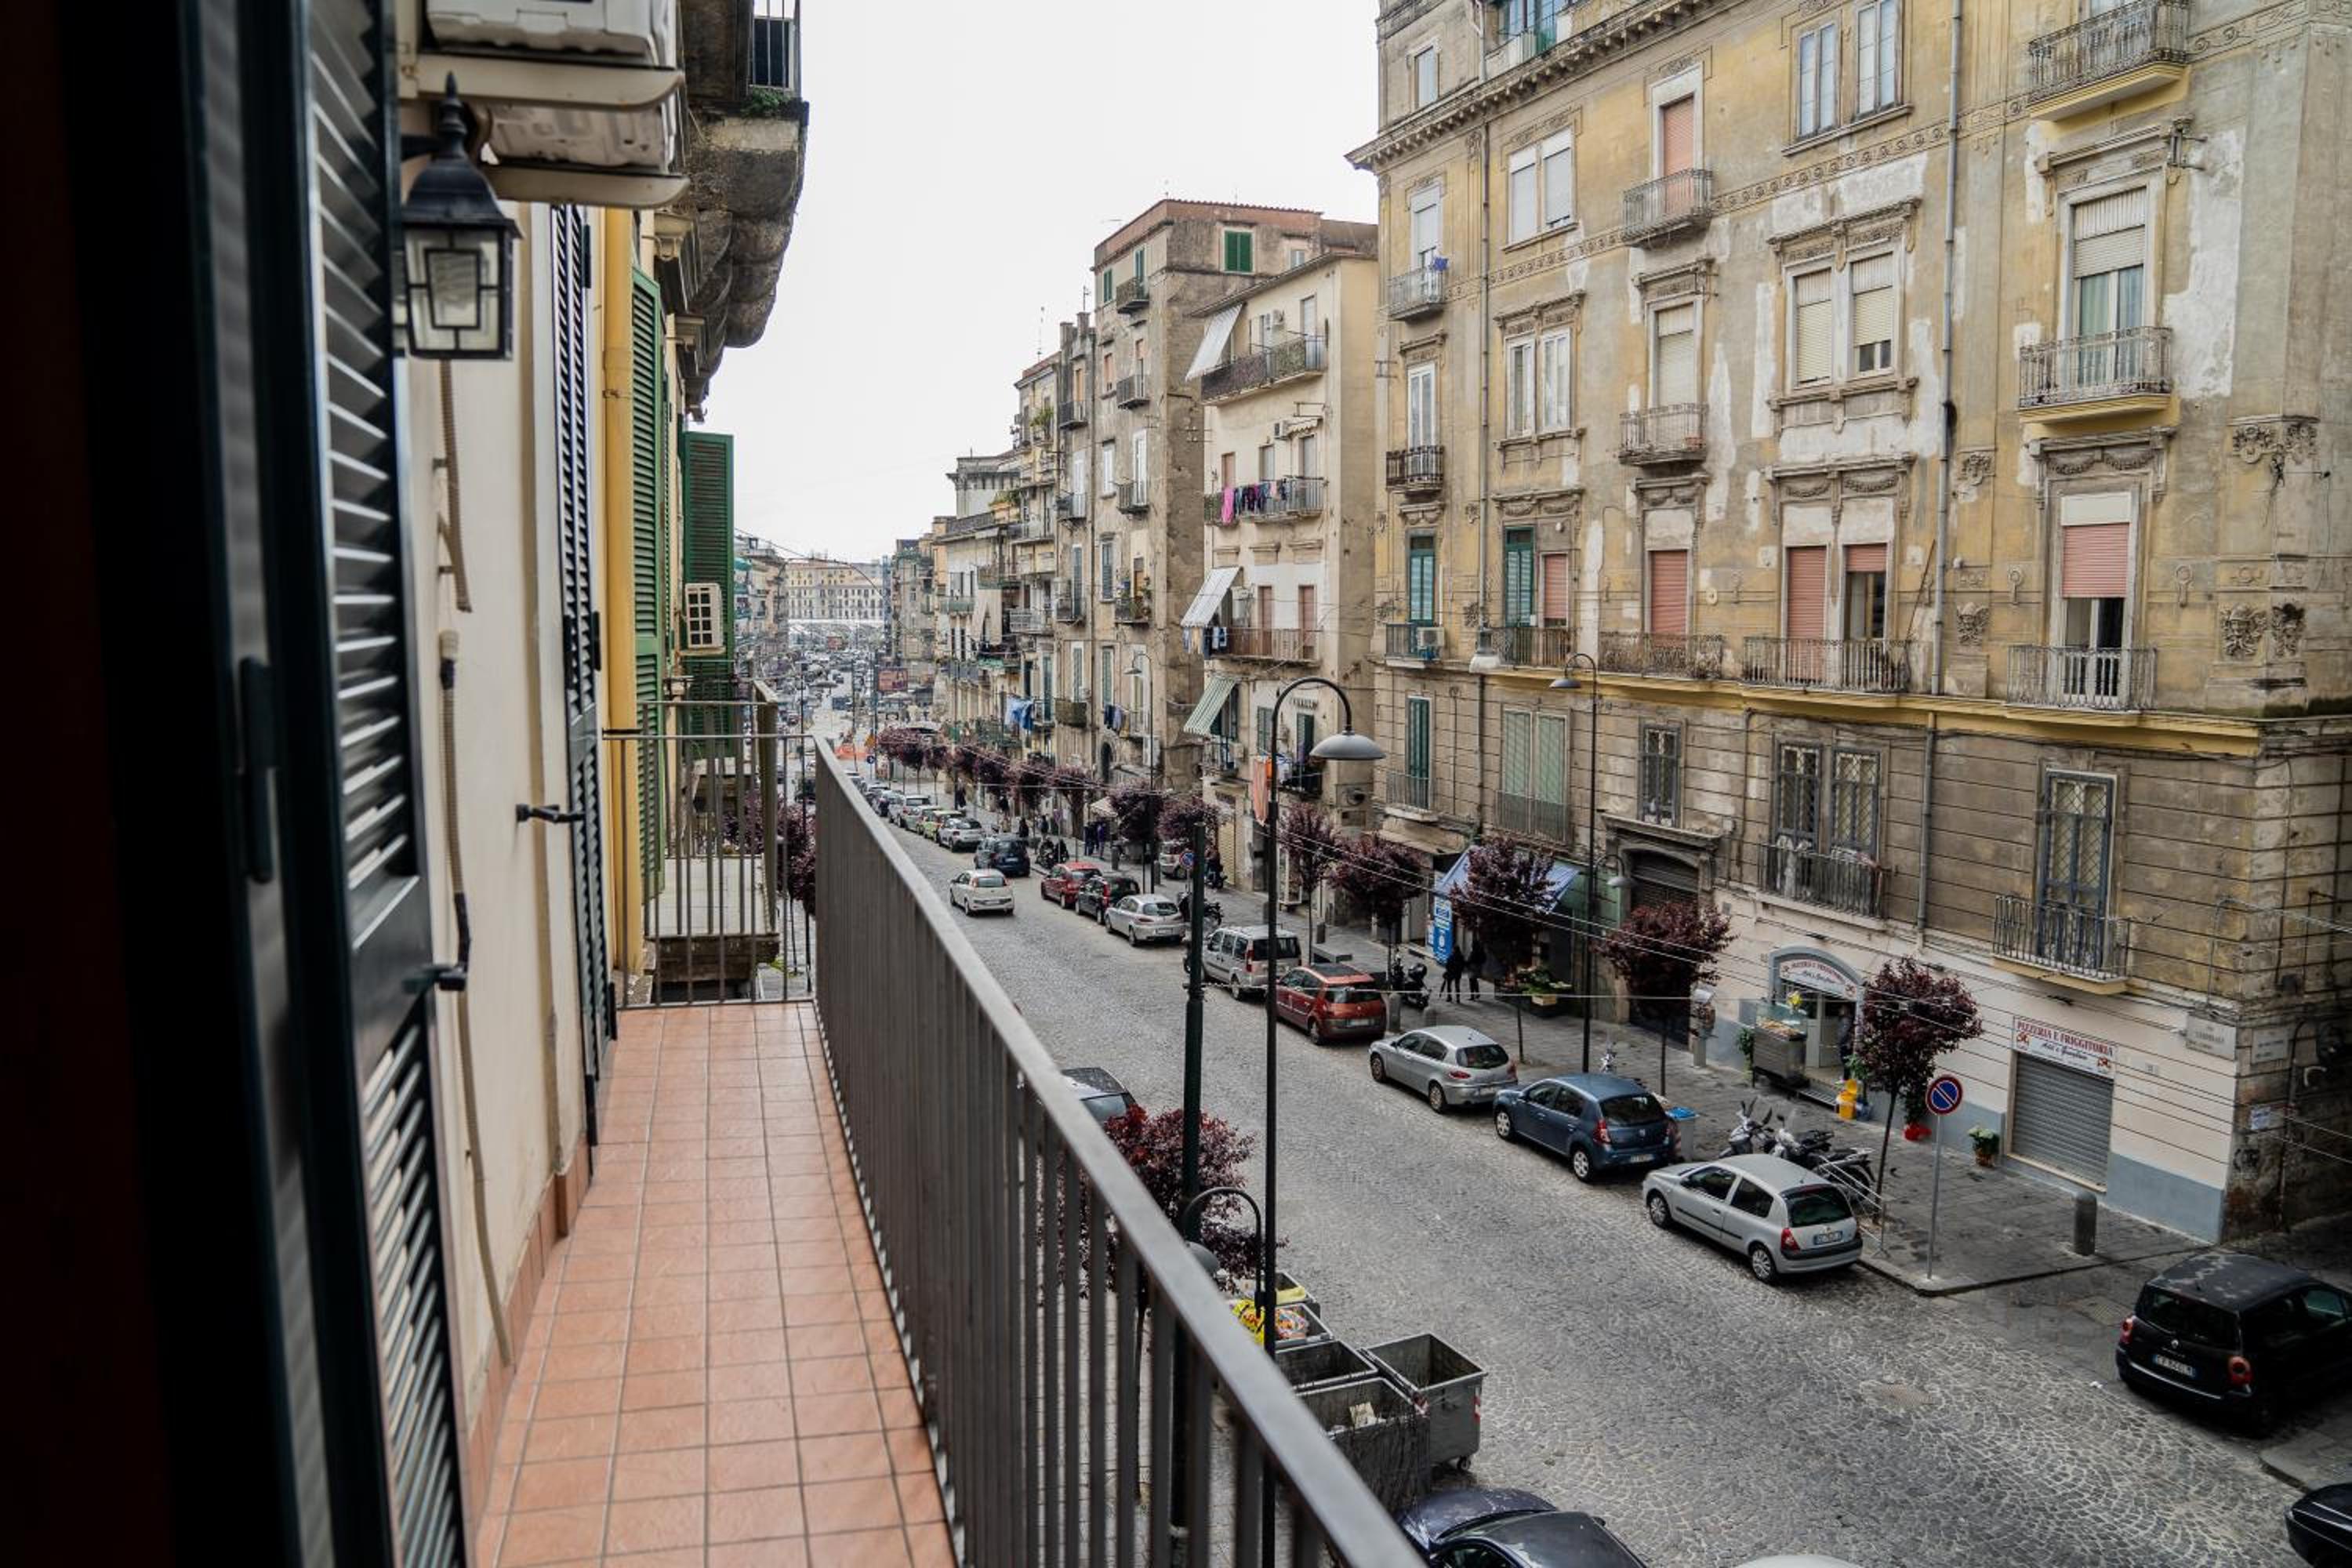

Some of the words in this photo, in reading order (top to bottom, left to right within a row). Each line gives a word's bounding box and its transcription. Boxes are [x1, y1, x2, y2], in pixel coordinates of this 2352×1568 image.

[2017, 1021, 2052, 1040] PIZZERIA
[2053, 1031, 2059, 1041] E
[2060, 1033, 2113, 1057] FRIGGITORIA
